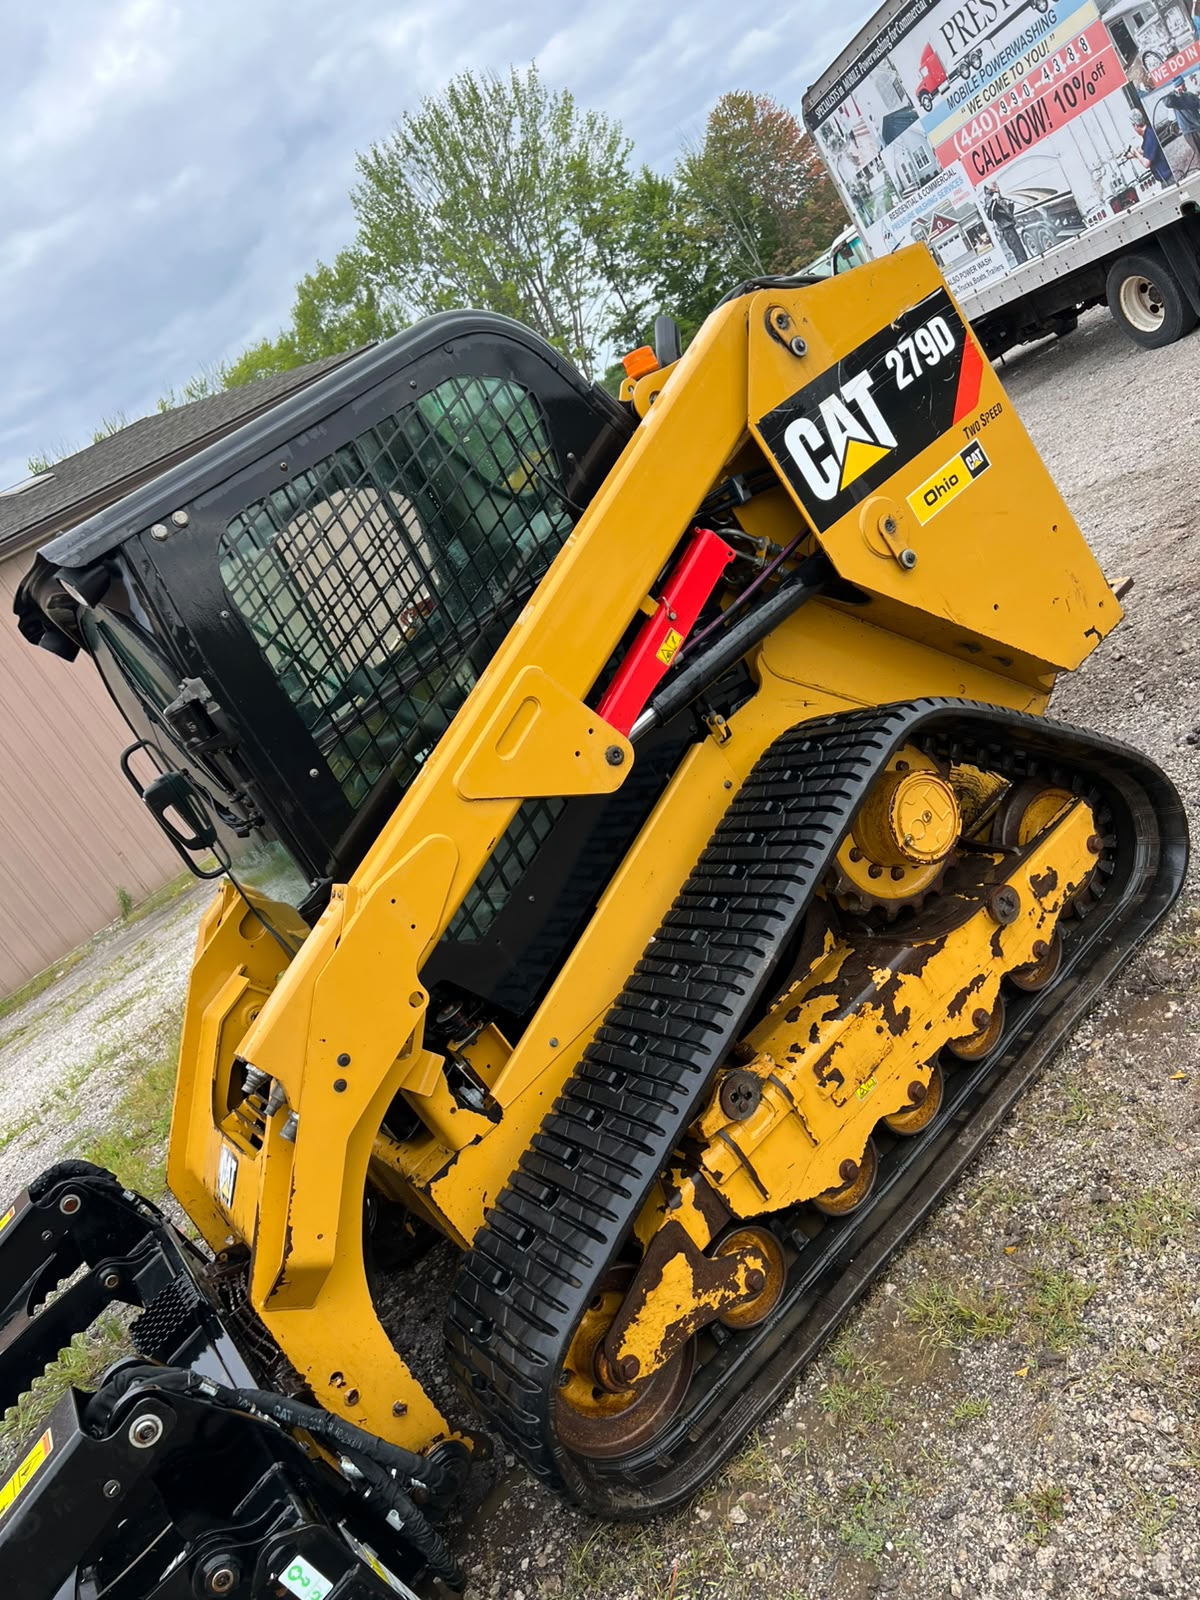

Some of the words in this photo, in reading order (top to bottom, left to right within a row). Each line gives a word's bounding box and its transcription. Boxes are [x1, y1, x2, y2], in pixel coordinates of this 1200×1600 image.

[841, 66, 861, 89] MOBILE
[946, 75, 980, 110] MOBILE
[980, 9, 1058, 83] POWERWASHING
[982, 73, 1011, 102] COME
[1009, 60, 1024, 80] TO
[1150, 65, 1169, 83] WE
[1168, 55, 1185, 73] DO
[1185, 46, 1199, 62] IN
[972, 134, 1010, 176] CALL
[1004, 97, 1053, 150] NOW!
[889, 198, 919, 221] RESIDENTIAL
[921, 168, 957, 197] COMMERCIAL
[960, 265, 978, 280] POWER
[977, 256, 993, 269] WASH
[885, 316, 956, 390] 279D
[784, 368, 898, 501] CAT
[923, 474, 959, 506] Ohio
[965, 448, 984, 471] CAT
